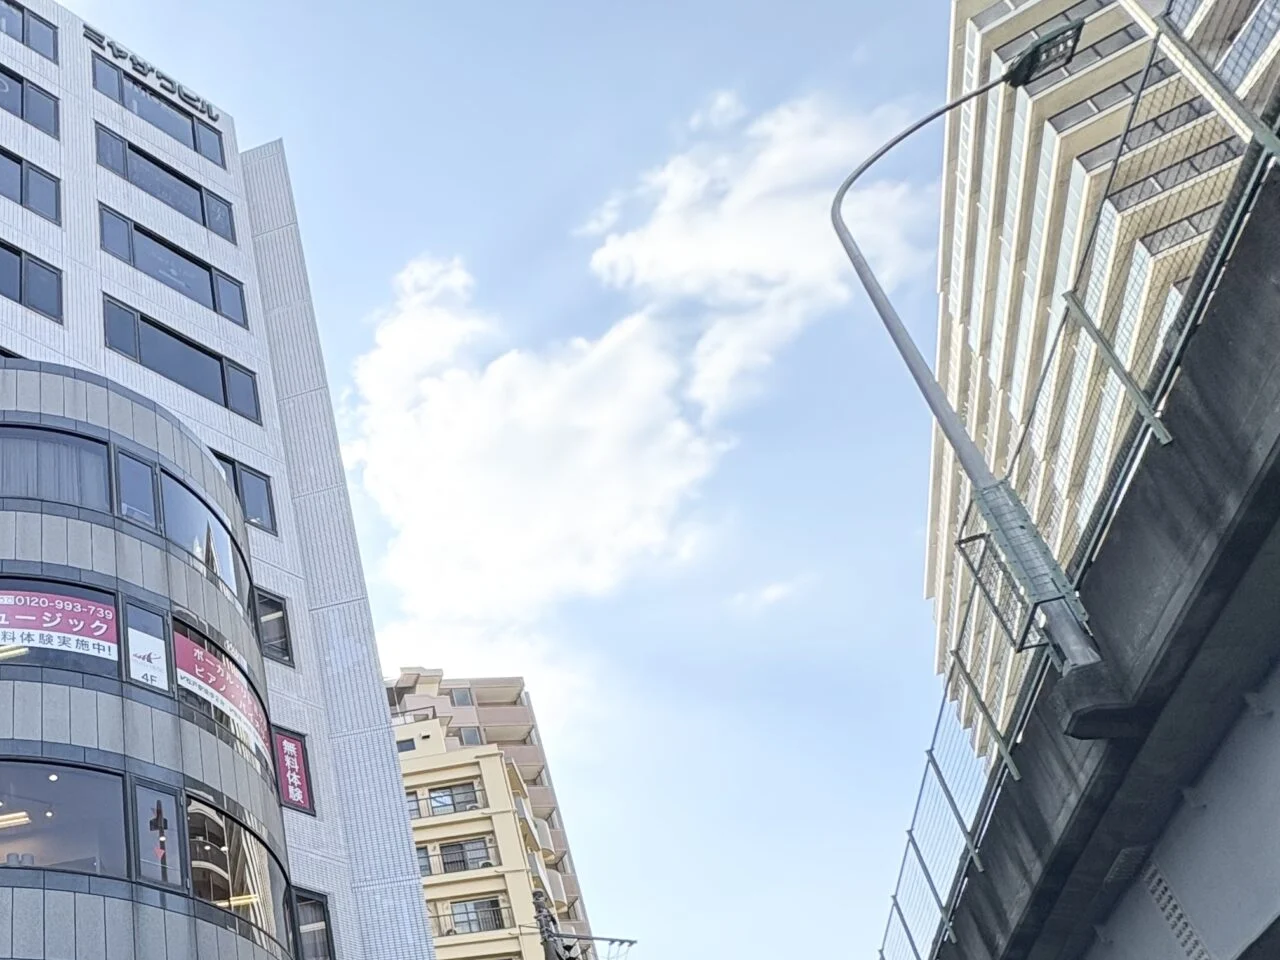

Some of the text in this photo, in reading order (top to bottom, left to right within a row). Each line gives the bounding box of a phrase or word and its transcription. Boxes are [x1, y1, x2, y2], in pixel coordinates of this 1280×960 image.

[82, 22, 220, 122] ミヤザワビル
[15, 595, 114, 620] 0120-993-739
[141, 673, 158, 685] 4F
[282, 739, 305, 804] 無料体験
